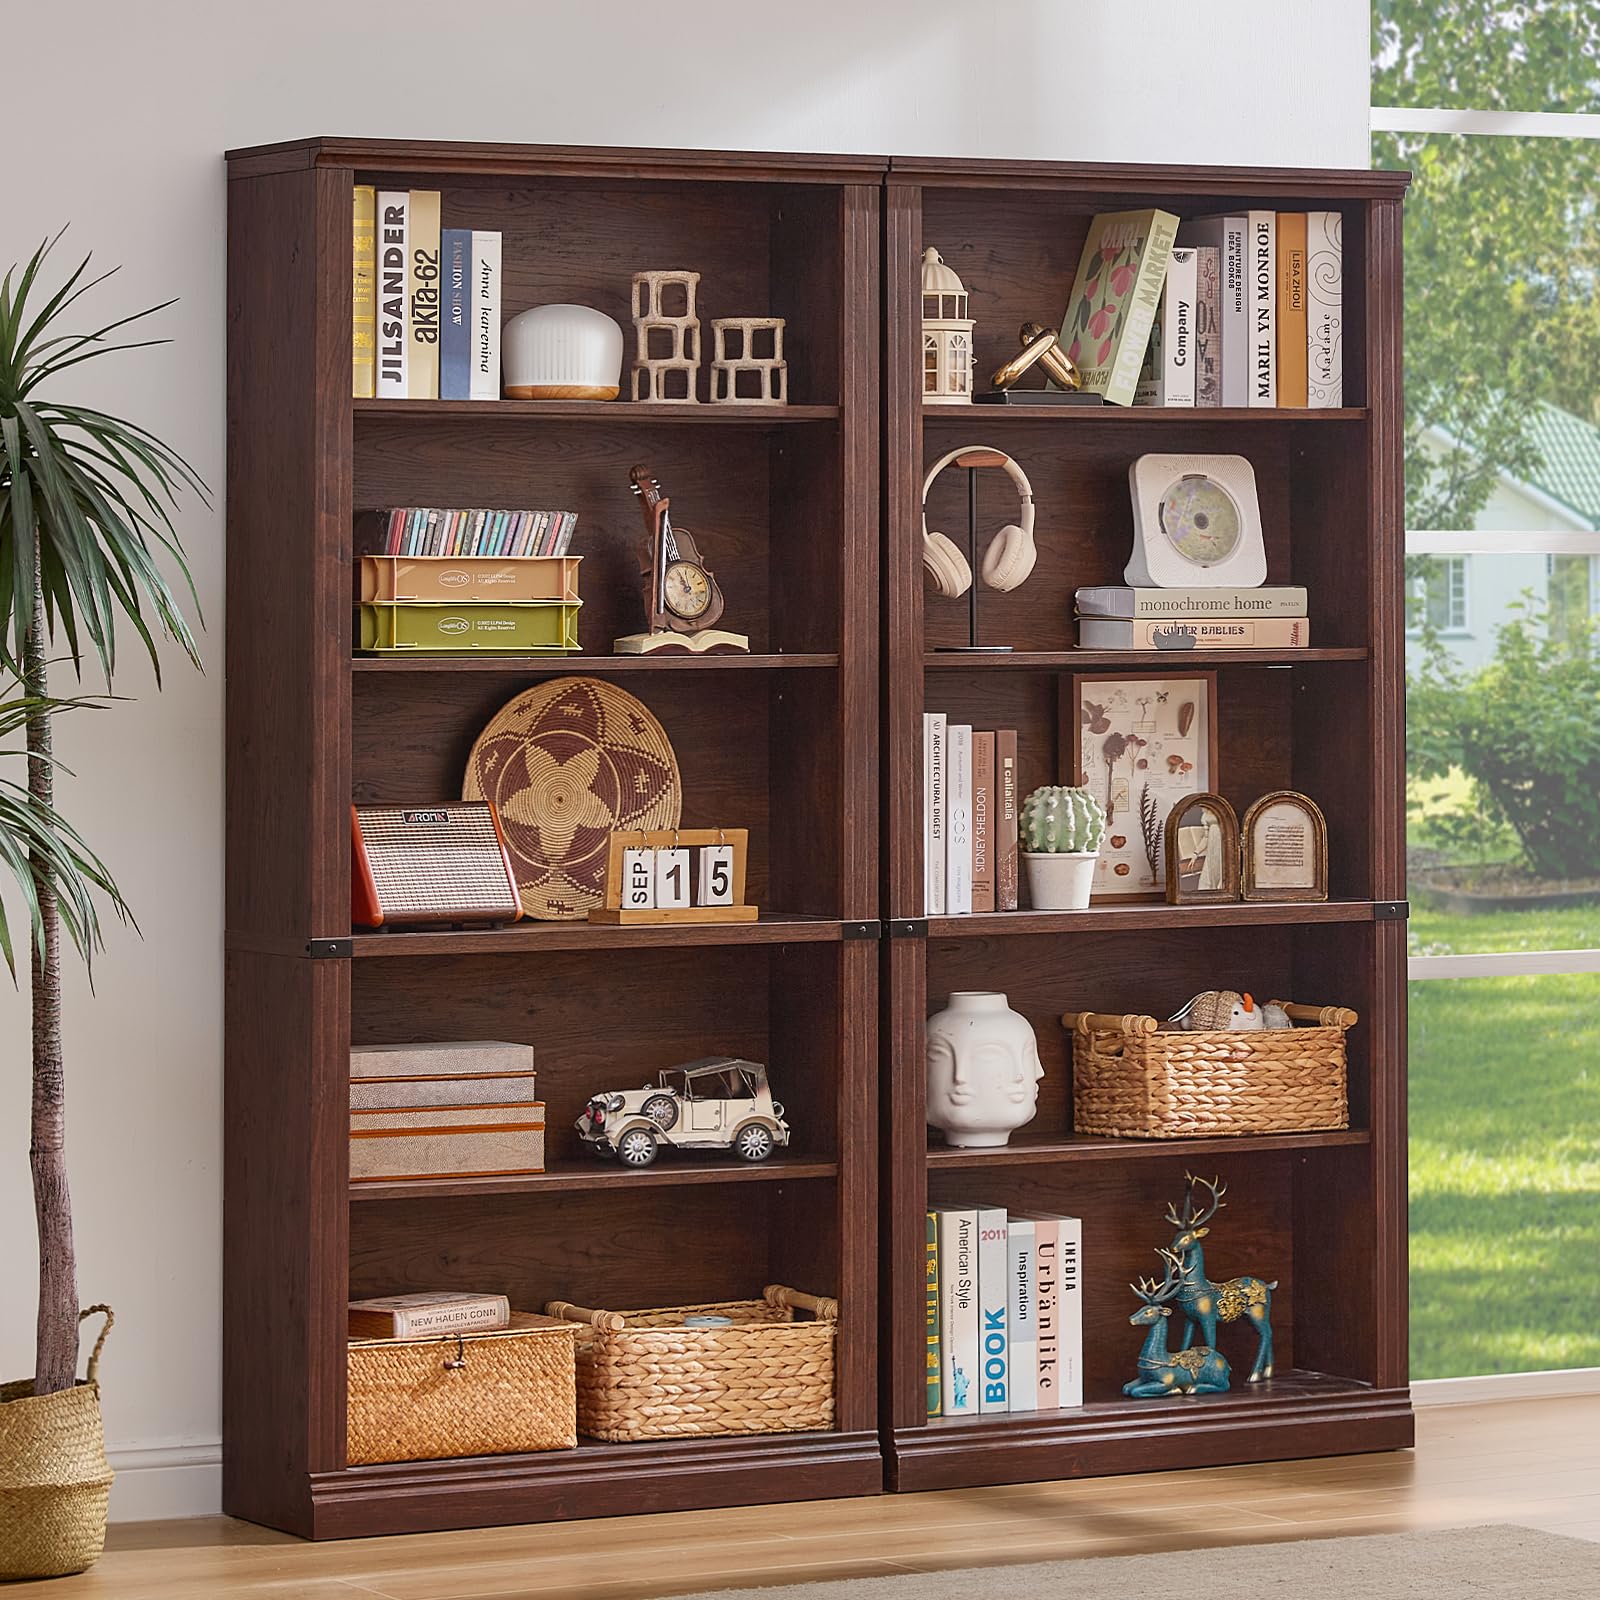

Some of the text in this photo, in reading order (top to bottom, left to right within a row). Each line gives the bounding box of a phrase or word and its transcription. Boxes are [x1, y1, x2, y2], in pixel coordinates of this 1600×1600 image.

[451, 241, 464, 326] FASHION SHOW
[480, 258, 493, 299] Anna
[1257, 222, 1270, 301] MONROE
[1292, 253, 1300, 309] LISA ZHOU
[1116, 307, 1154, 391] FLOWER
[1138, 224, 1174, 308] MARKET
[1174, 301, 1189, 367] Company
[1322, 313, 1331, 379] Madame
[1140, 597, 1230, 611] monochrome
[1234, 596, 1272, 610] home
[933, 734, 941, 807] ARCHITECTURAL
[408, 812, 446, 822] AROMA
[933, 808, 941, 840] DIGEST
[953, 808, 966, 844] COS
[976, 787, 986, 835] SHELDON
[975, 837, 986, 872] SIDNEY
[631, 862, 648, 904] SEP
[981, 1229, 1007, 1241] 2011
[955, 1218, 972, 1309] American Style
[1017, 1251, 1029, 1320] Inspiration
[410, 1317, 433, 1327] NEW
[470, 1308, 496, 1319] CONN
[984, 1306, 1006, 1404] BOOK
